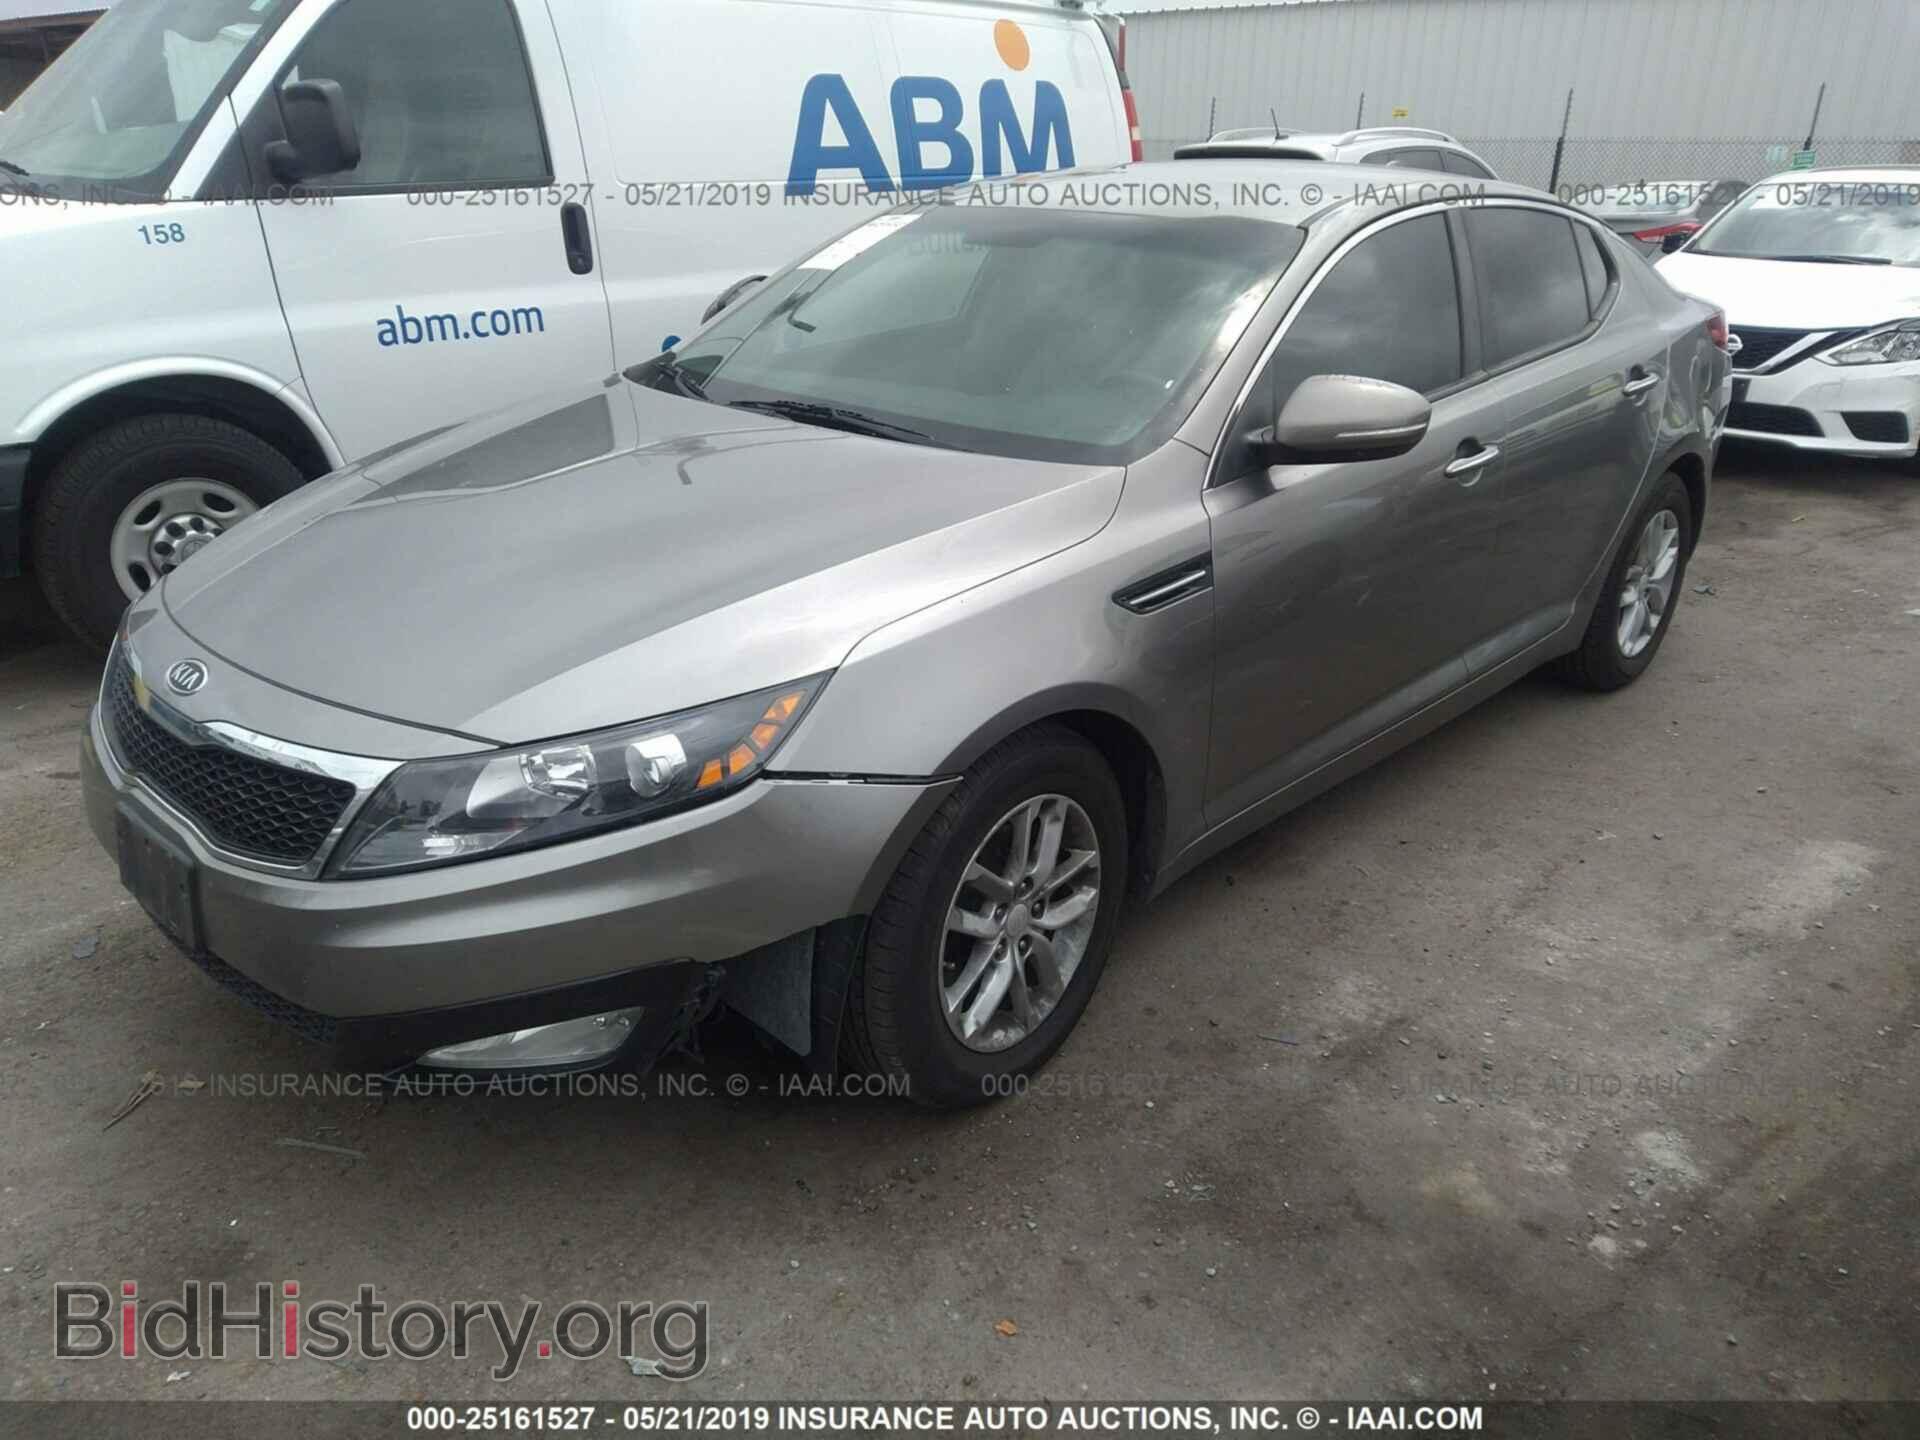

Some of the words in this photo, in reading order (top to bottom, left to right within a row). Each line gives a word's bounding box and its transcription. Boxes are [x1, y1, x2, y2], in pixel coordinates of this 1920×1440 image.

[784, 73, 1076, 196] ABM
[137, 222, 186, 246] 158
[376, 304, 545, 347] abm.com
[171, 663, 200, 689] KIA
